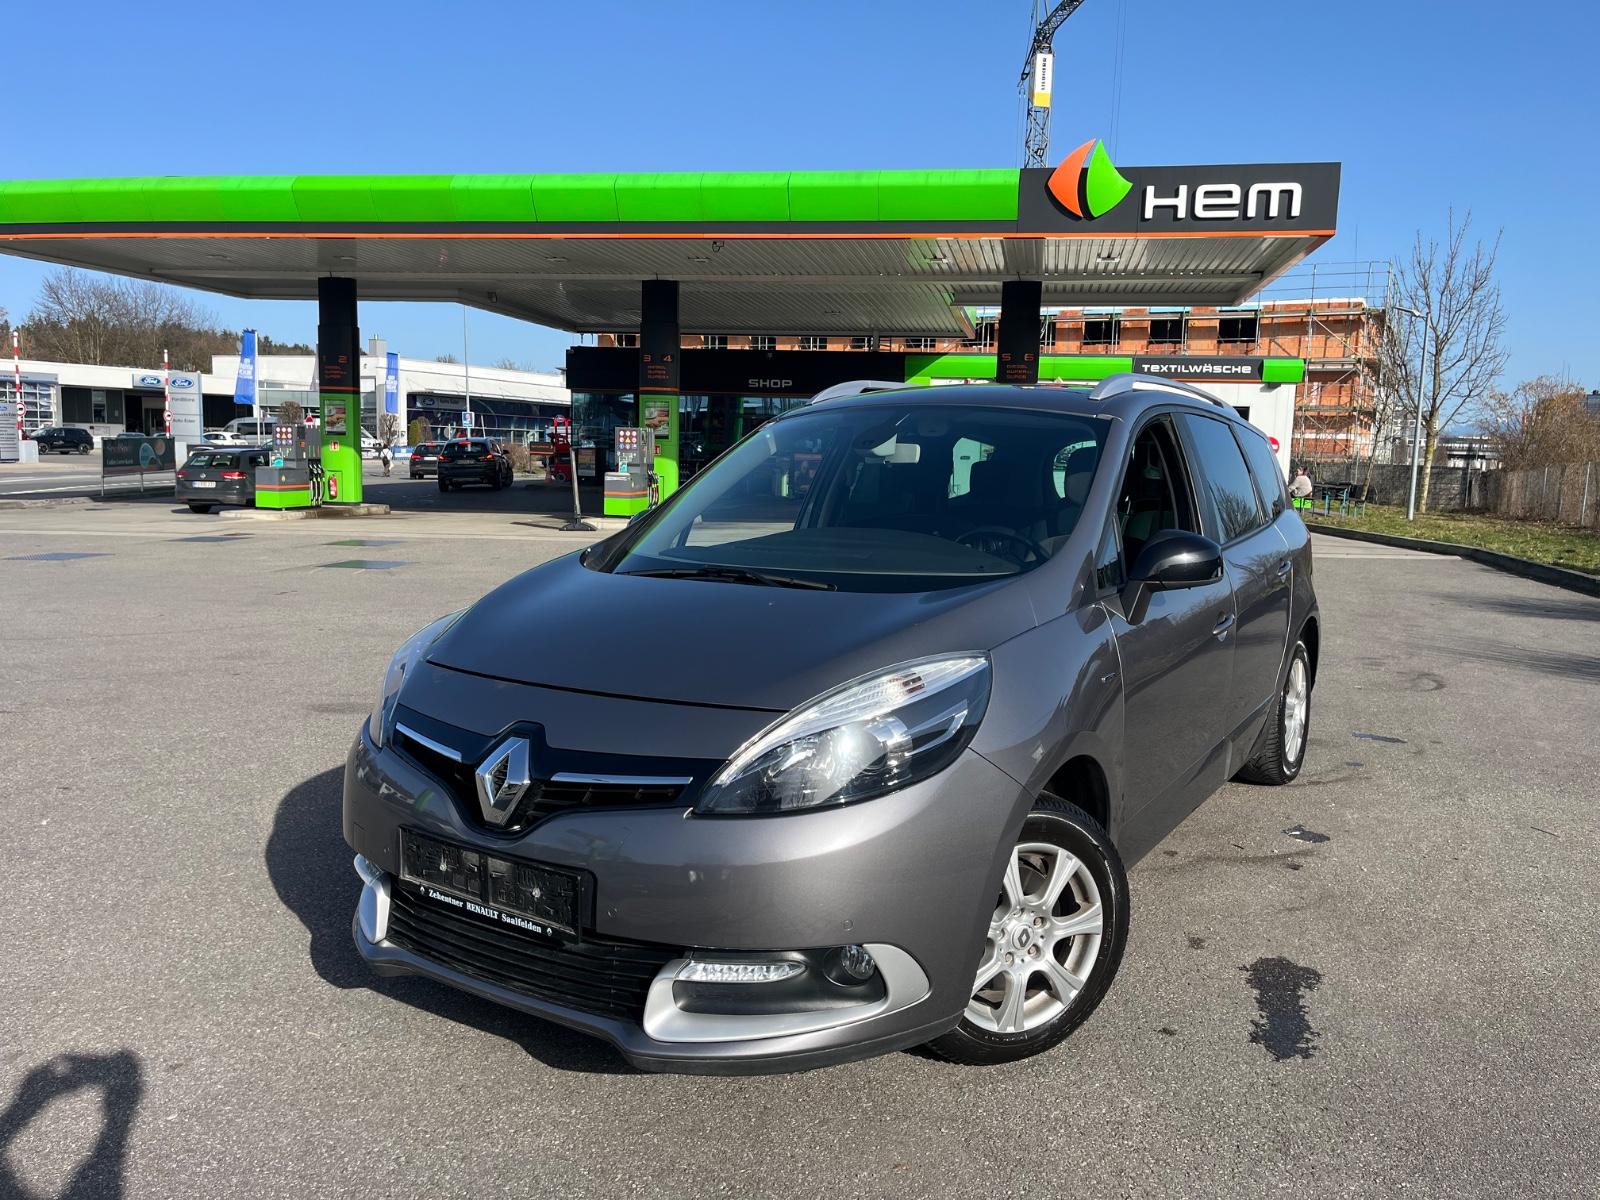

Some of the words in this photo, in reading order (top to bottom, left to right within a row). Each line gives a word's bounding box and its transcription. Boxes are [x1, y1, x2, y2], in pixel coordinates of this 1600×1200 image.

[643, 354, 651, 362] 3
[1001, 353, 1011, 361] 5
[1024, 353, 1034, 361] 6
[748, 379, 793, 388] SHOP
[466, 902, 498, 920] RENAULT
[501, 913, 542, 934] Saalfelden
